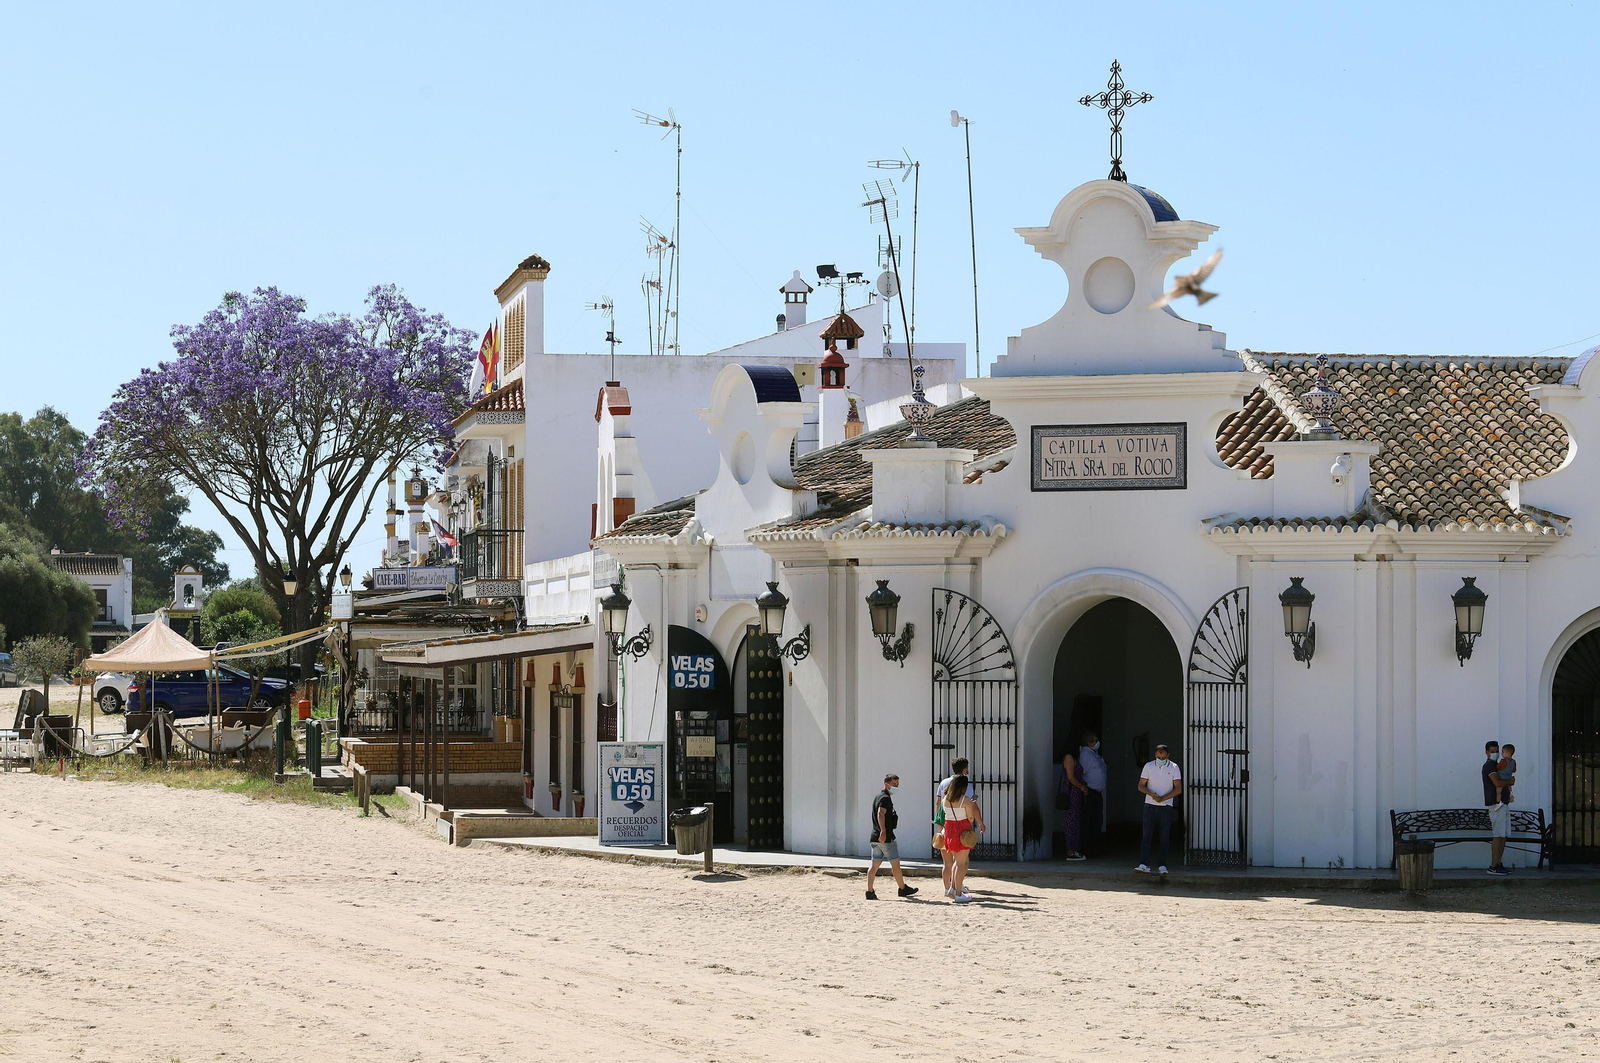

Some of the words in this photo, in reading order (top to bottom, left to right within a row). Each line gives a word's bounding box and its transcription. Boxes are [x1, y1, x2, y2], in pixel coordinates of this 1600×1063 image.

[1049, 439, 1106, 455] CAPILLA
[1116, 438, 1169, 453] VOTIVA
[671, 655, 715, 672] VELAS
[674, 672, 711, 689] 0,50
[611, 767, 655, 784] VELAS
[616, 784, 652, 801] 0,50
[606, 816, 658, 825] RECUERDOS
[613, 824, 649, 832] DESPACHO
[617, 830, 645, 838] OFICIAL
